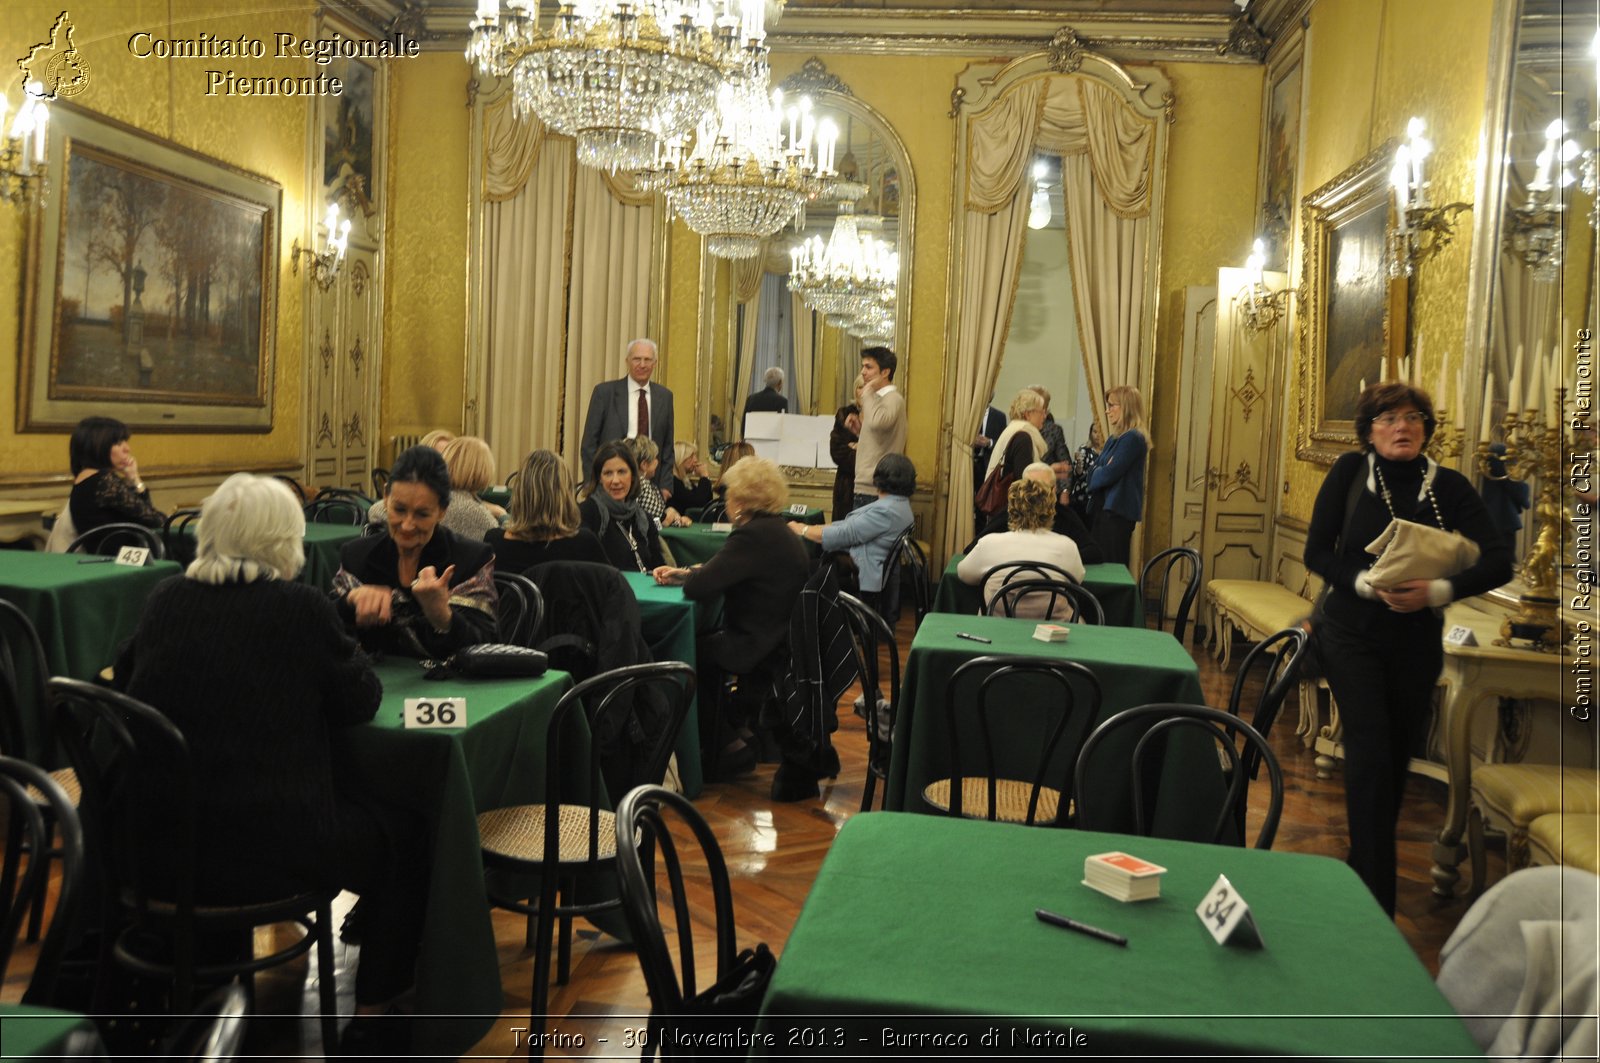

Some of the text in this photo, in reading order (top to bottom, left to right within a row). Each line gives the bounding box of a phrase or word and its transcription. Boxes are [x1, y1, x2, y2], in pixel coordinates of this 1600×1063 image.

[793, 504, 804, 514] 39
[122, 550, 142, 564] 43
[416, 702, 456, 725] 36
[1204, 887, 1237, 932] 34
